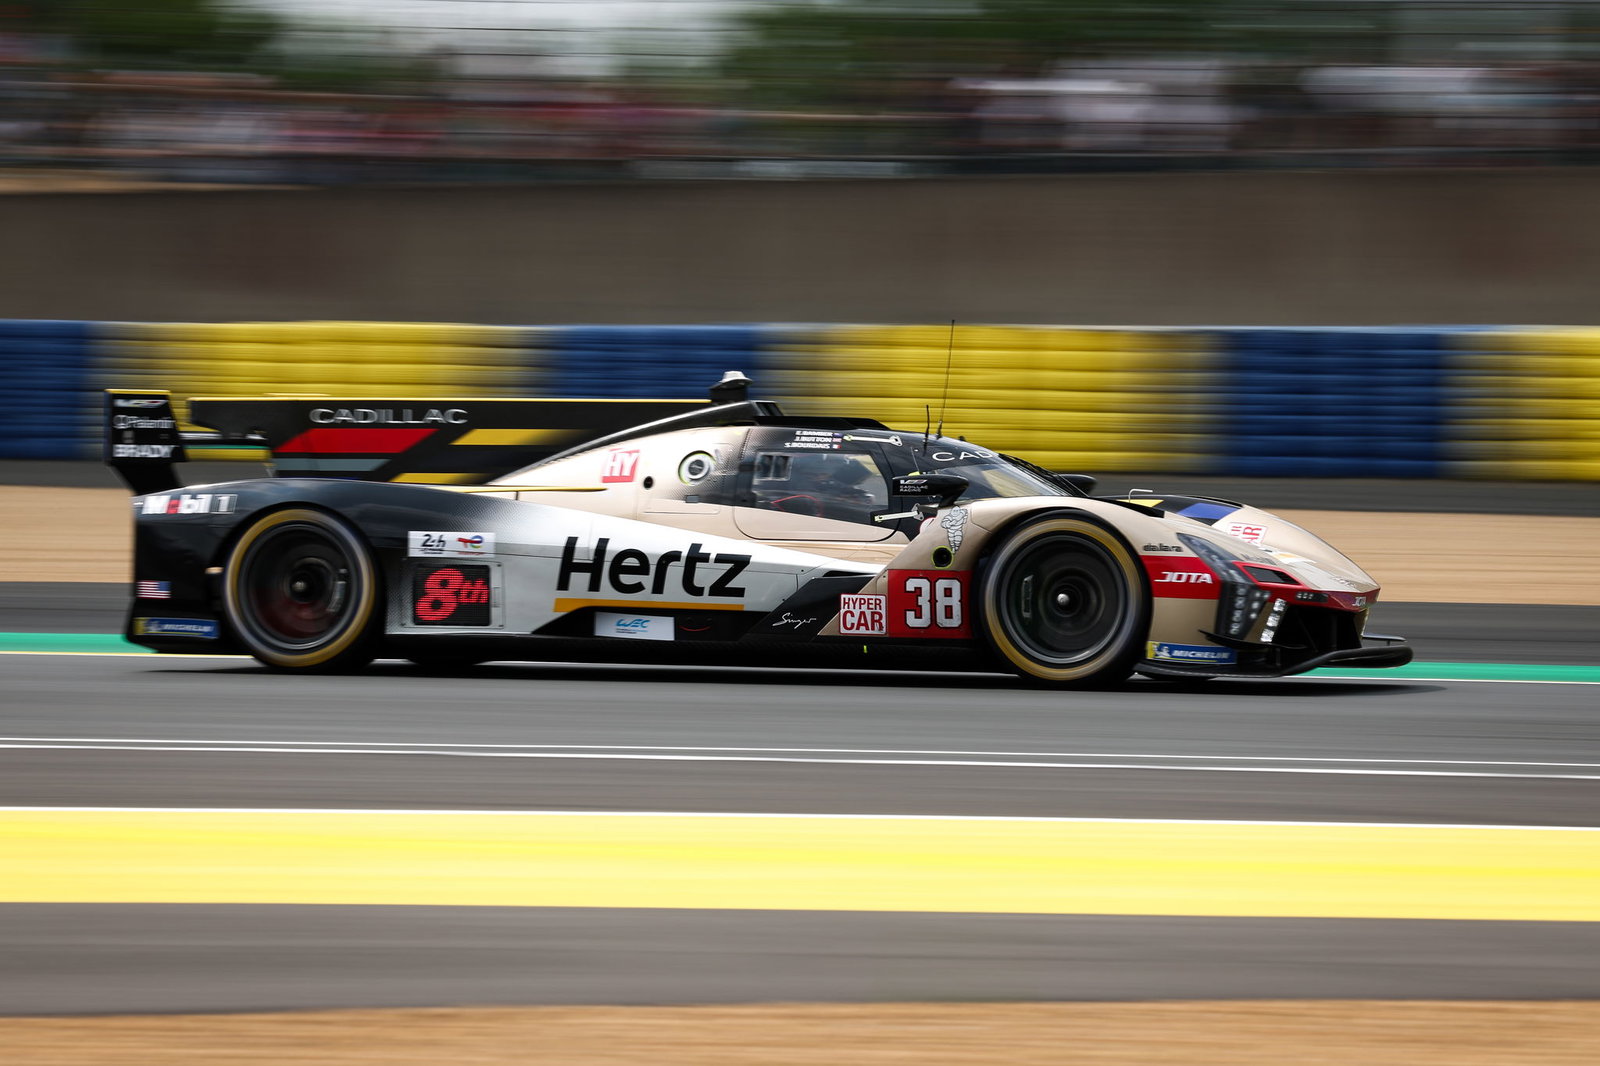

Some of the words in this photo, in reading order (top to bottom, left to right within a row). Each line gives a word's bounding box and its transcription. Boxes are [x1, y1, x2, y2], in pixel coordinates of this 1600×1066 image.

[309, 408, 468, 424] CADILLAC
[601, 450, 640, 477] HY
[556, 536, 752, 598] Hertz
[1154, 571, 1213, 584] JOTA
[416, 568, 490, 621] 8th
[842, 597, 882, 611] HYPER
[905, 577, 962, 629] 38
[615, 618, 651, 629] WEC
[842, 610, 884, 632] CAR
[1172, 649, 1231, 660] MICHELIN
